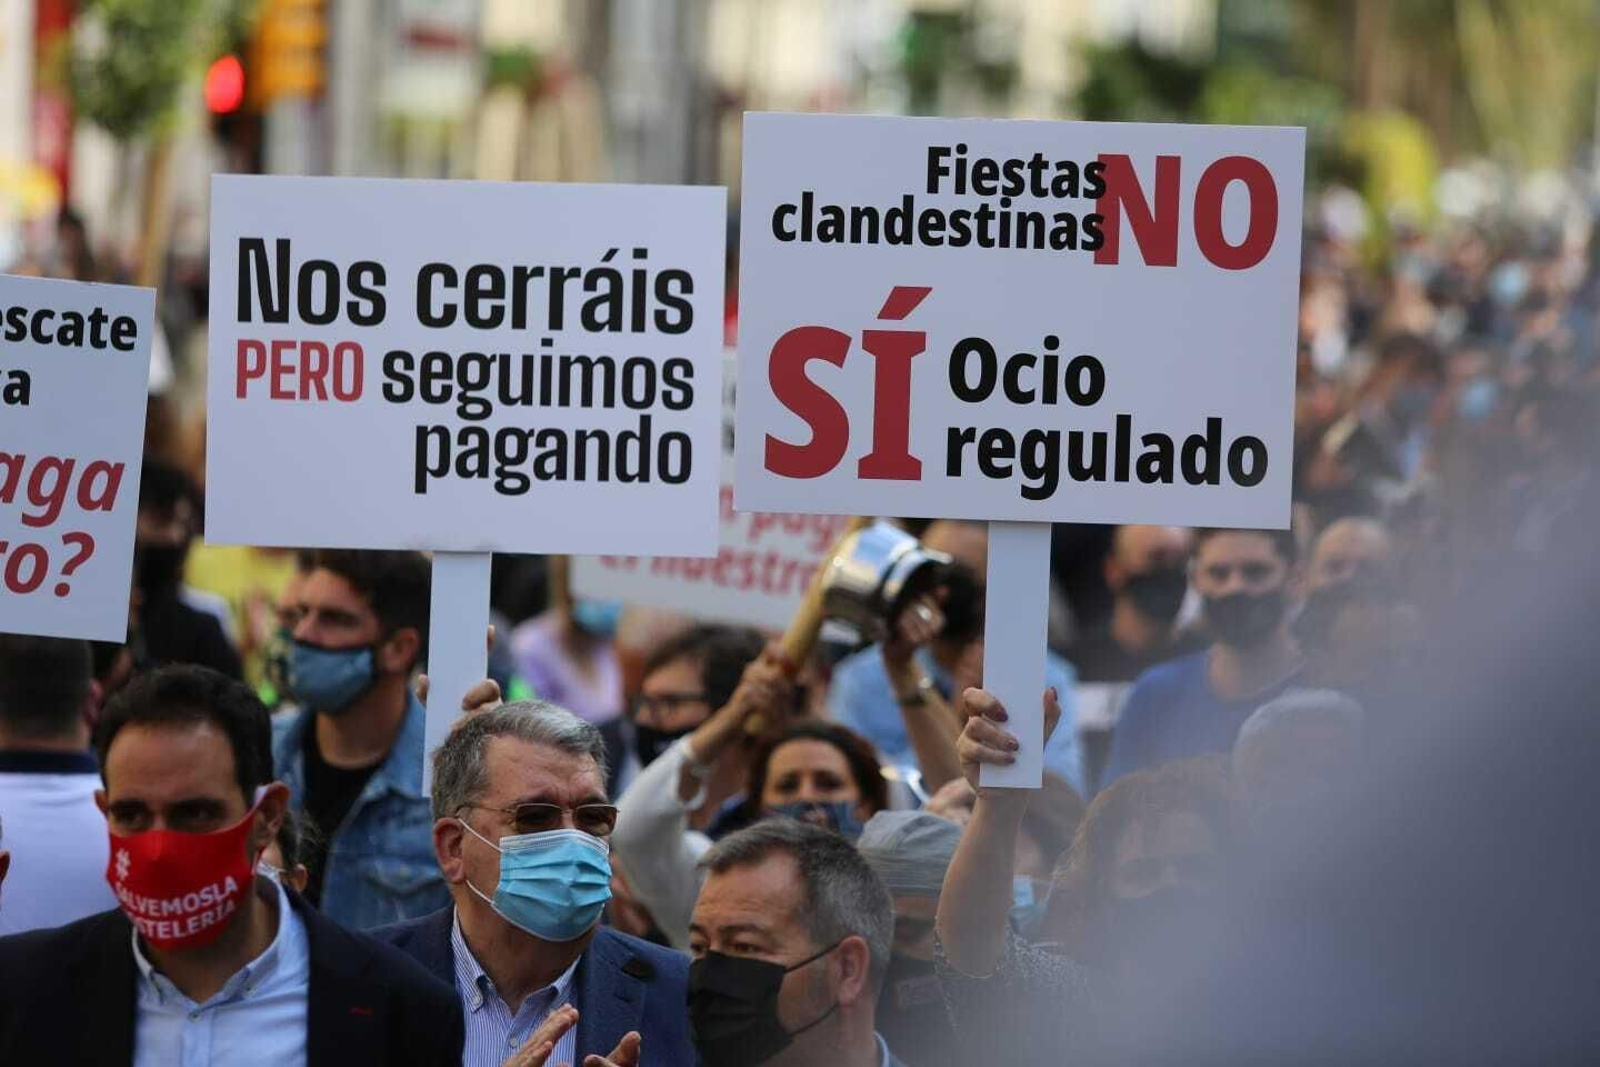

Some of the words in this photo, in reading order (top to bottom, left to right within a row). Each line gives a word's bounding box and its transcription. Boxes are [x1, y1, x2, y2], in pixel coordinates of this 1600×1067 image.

[926, 142, 1107, 201] Fiestas
[1094, 153, 1279, 270] NO
[771, 191, 1105, 252] clandestinas
[237, 237, 387, 327] Nos
[416, 246, 694, 335] cerráis
[0, 303, 138, 352] scate
[236, 338, 364, 403] PERO
[382, 337, 694, 421] seguimos
[764, 286, 932, 481] SÍ
[948, 334, 1106, 407] Ocio
[414, 414, 692, 496] pagando
[946, 413, 1269, 501] regulado
[0, 532, 95, 597] o?
